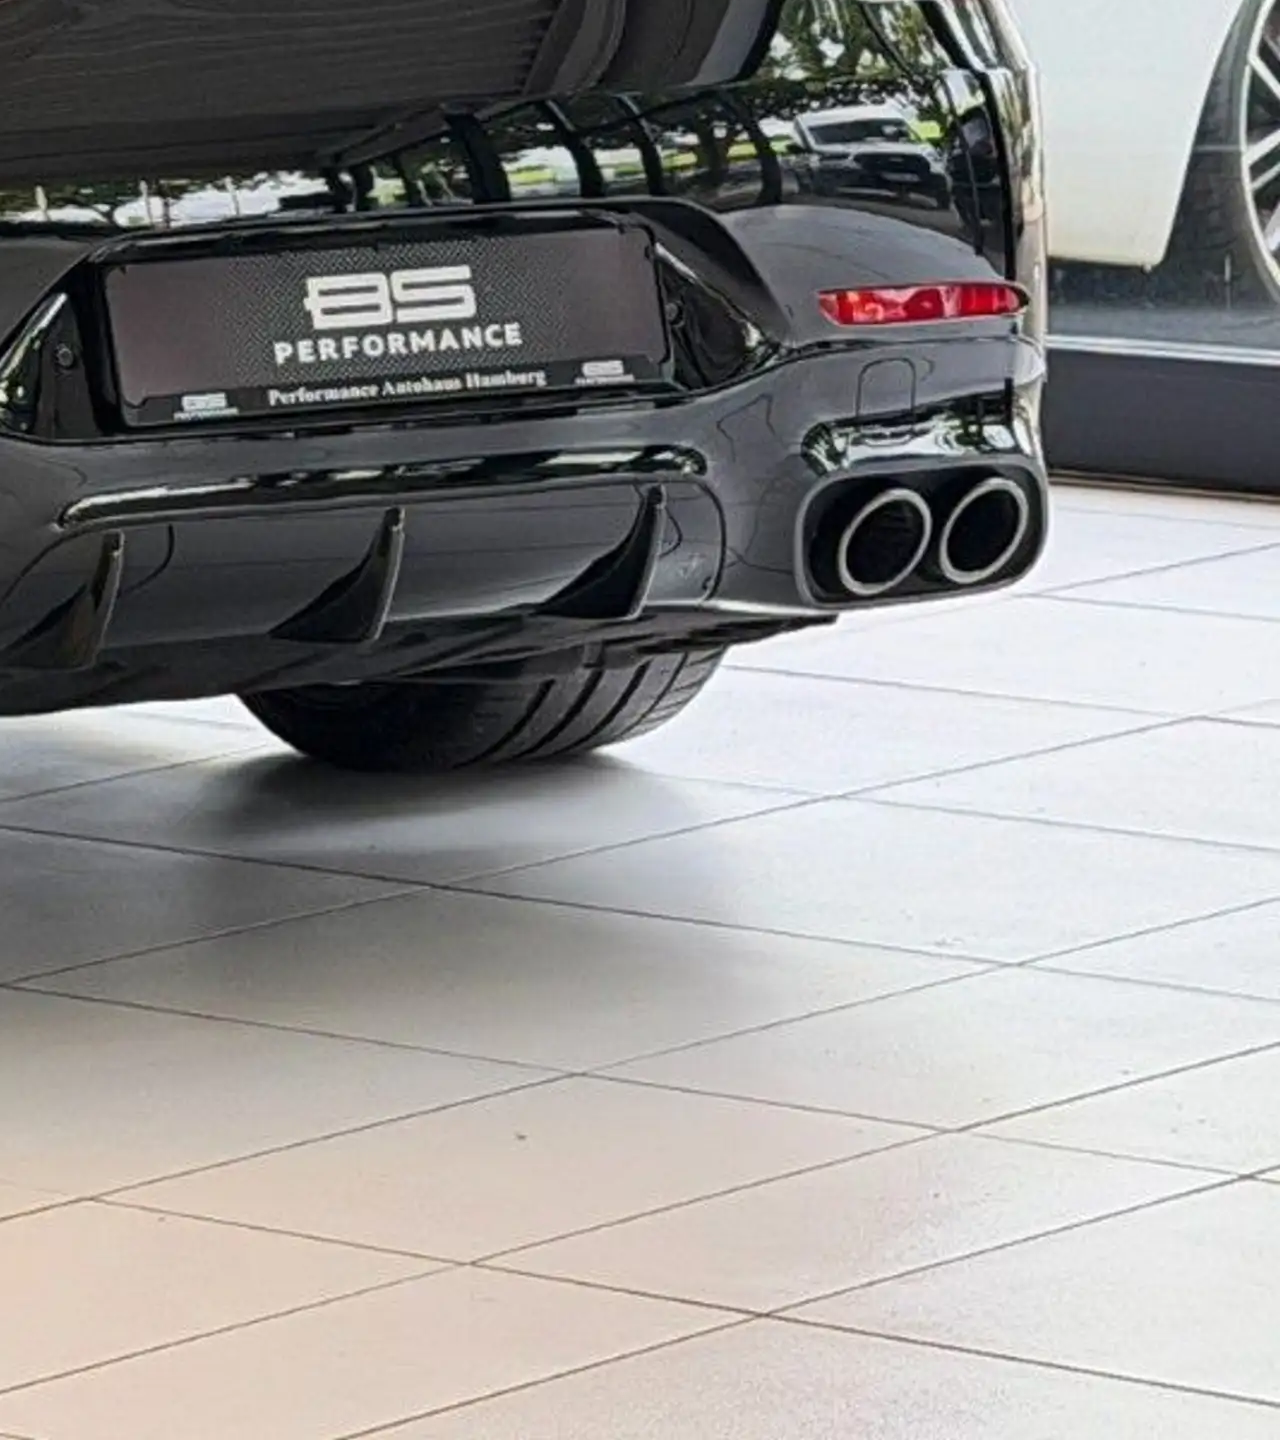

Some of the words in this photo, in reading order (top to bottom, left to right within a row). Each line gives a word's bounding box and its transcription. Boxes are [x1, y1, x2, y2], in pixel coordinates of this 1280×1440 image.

[273, 322, 523, 365] PERFORMANCE
[267, 384, 380, 408] Performance
[382, 377, 463, 397] Autohaus
[465, 368, 547, 389] Hamburg
